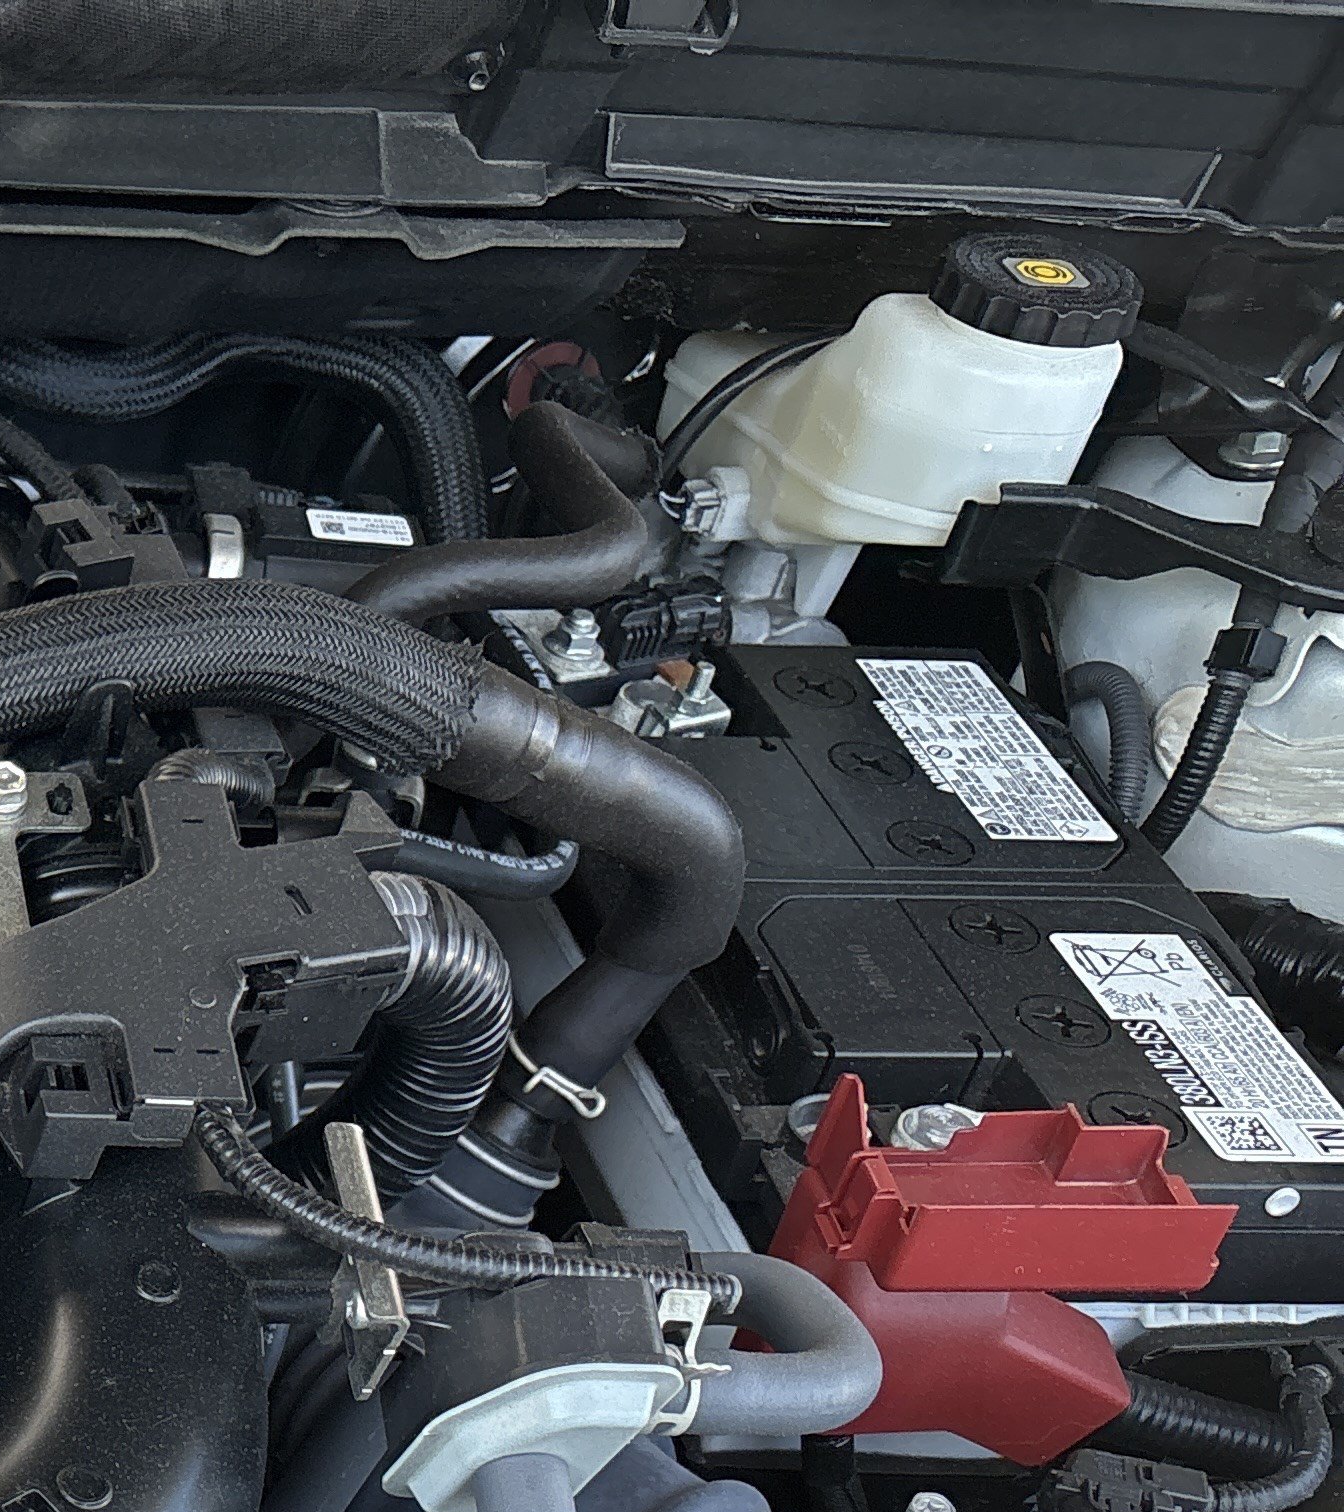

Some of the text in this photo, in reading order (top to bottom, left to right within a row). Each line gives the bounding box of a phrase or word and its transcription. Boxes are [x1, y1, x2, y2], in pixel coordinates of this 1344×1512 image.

[1164, 952, 1193, 971] Pb
[1186, 939, 1225, 977] CLARIOS
[1122, 1021, 1217, 1105] 380LN3-ISS
